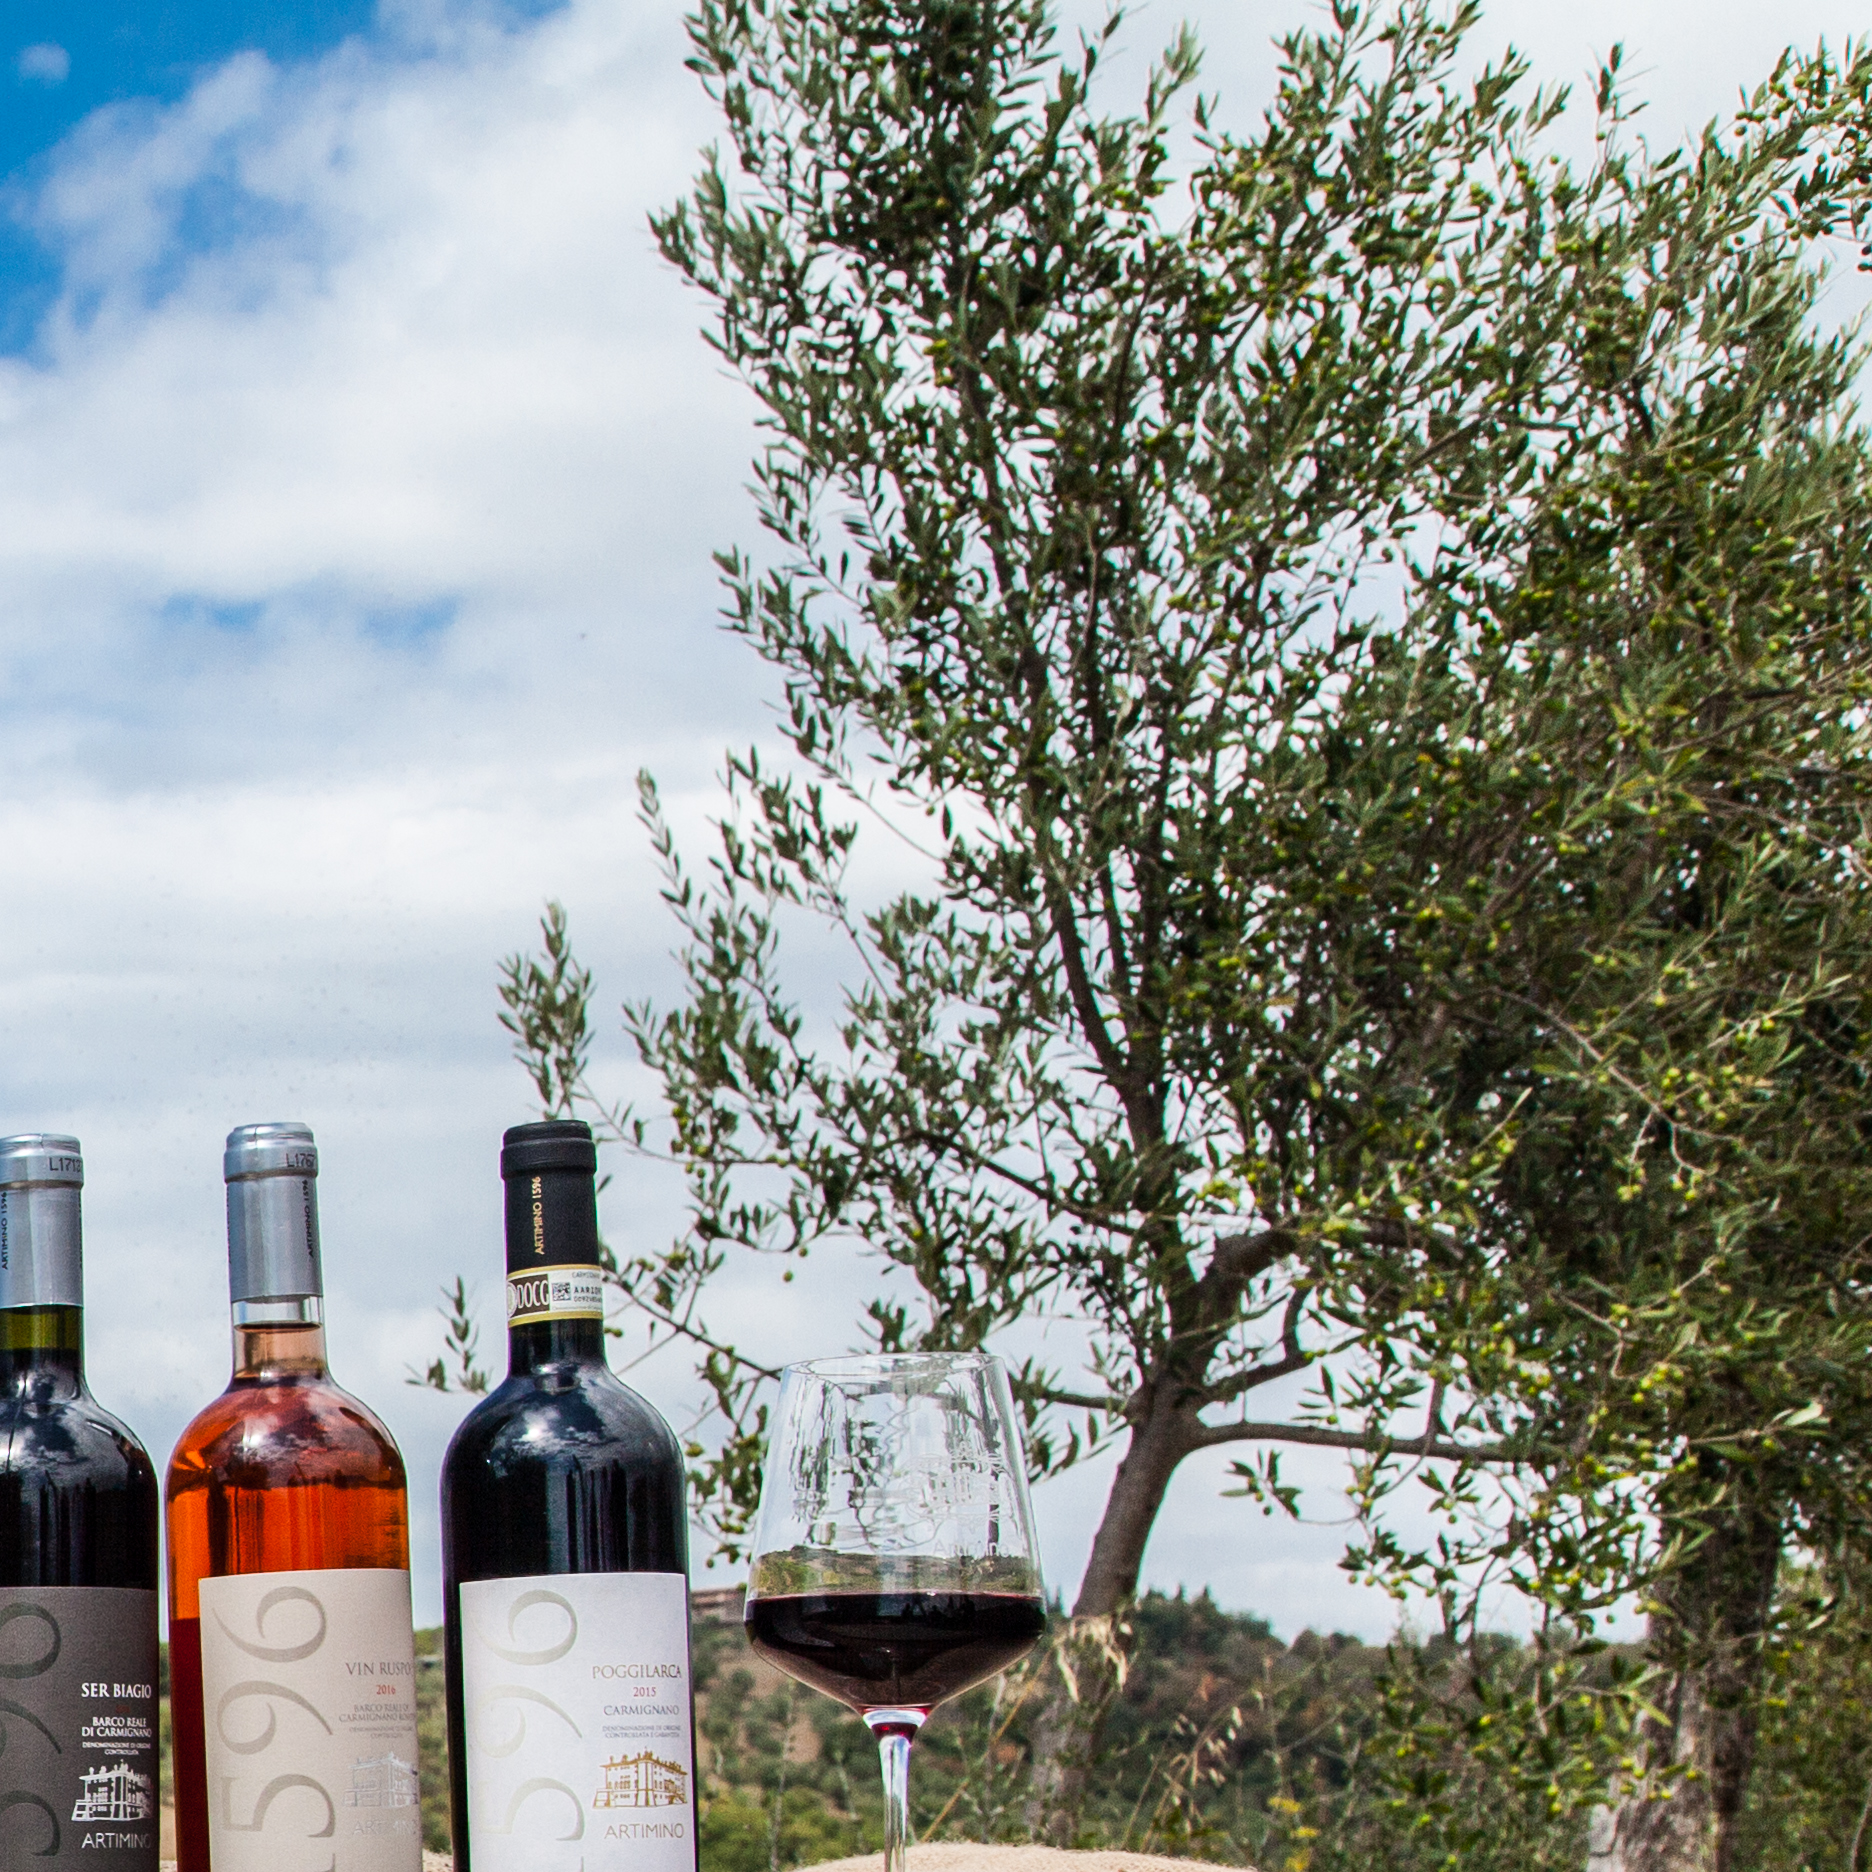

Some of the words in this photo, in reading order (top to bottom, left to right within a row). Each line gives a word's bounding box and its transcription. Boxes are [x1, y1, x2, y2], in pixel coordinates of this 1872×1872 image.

[531, 1176, 542, 1199] 1596
[532, 1201, 545, 1255] ARTIMINO
[0, 1217, 9, 1270] ARTIMINO
[516, 1279, 550, 1310] DOCG
[344, 1662, 375, 1676] VIN
[379, 1661, 412, 1676] RUSPO
[592, 1664, 682, 1680] POGGILARCA
[81, 1682, 110, 1698] SER
[113, 1683, 152, 1699] BIAGIO
[376, 1684, 396, 1696] 2016
[633, 1686, 657, 1698] 2015
[604, 1704, 680, 1716] CARMIGNANO
[92, 1716, 125, 1727] BARCO
[126, 1717, 147, 1728] REALE
[81, 1726, 94, 1737] DI
[96, 1727, 153, 1738] CARMIGNANO
[352, 1819, 418, 1837] ARTMIN
[604, 1822, 685, 1840] ARTIMINO
[81, 1832, 152, 1849] ARTIMINO
